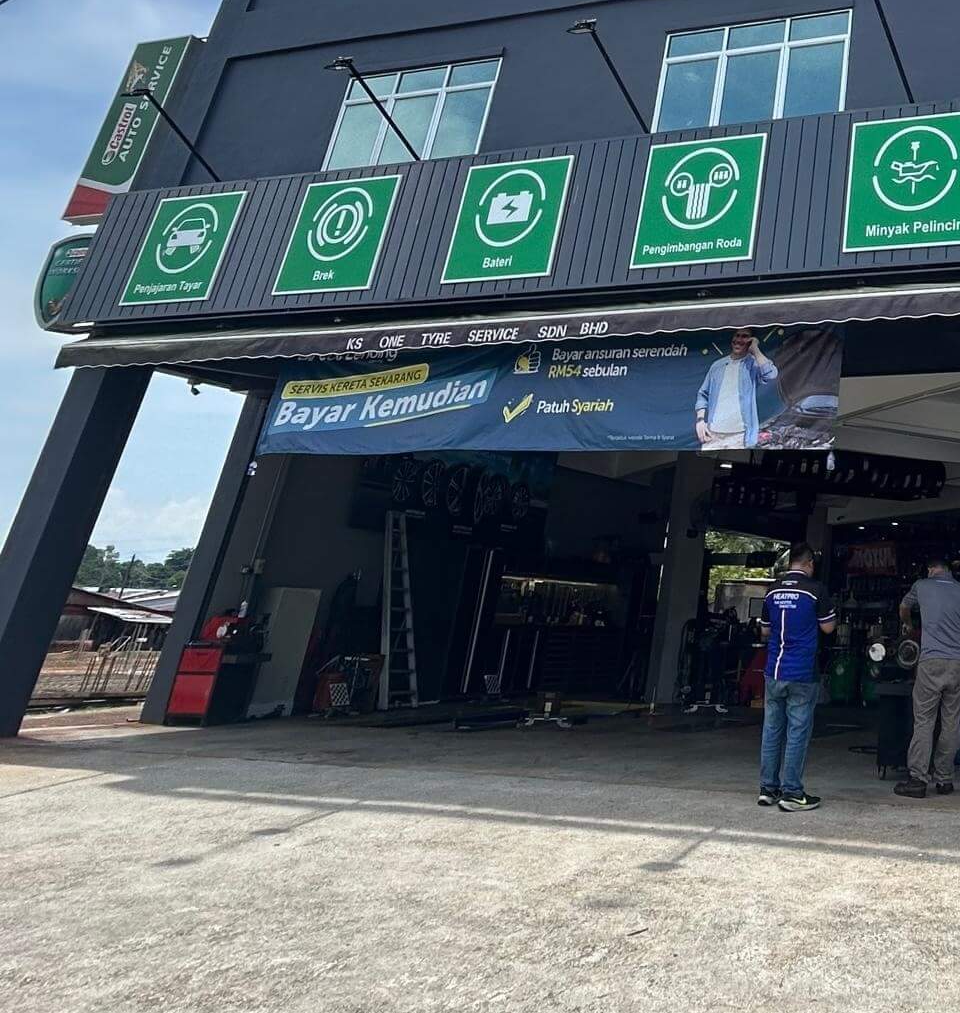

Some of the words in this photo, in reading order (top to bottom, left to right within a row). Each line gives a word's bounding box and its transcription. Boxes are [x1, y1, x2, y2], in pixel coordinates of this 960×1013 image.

[118, 117, 142, 163] AUTO
[865, 222, 910, 238] Minyak
[642, 240, 714, 256] Pengimbangan
[716, 236, 742, 250] Roda
[482, 255, 513, 269] Bateri
[312, 270, 335, 281] Brek
[178, 280, 203, 293] Tayar
[346, 337, 364, 350] KS
[379, 334, 406, 349] ONE
[421, 332, 453, 346] TYRE
[468, 327, 520, 342] SERVICE
[537, 324, 568, 338] SDN
[579, 321, 609, 335] BHD
[552, 347, 584, 363] Bayar
[584, 347, 631, 360] ansuran
[632, 344, 688, 358] serendah
[548, 364, 582, 379] RM54
[582, 363, 628, 377] sebulan
[289, 382, 329, 395] SERVIS
[329, 379, 367, 393] KERETA
[369, 369, 422, 388] SEKARANG
[273, 401, 358, 430] Bayar
[359, 379, 488, 421] Kemudian
[536, 399, 570, 414] Patuh
[571, 398, 615, 415] Syariah
